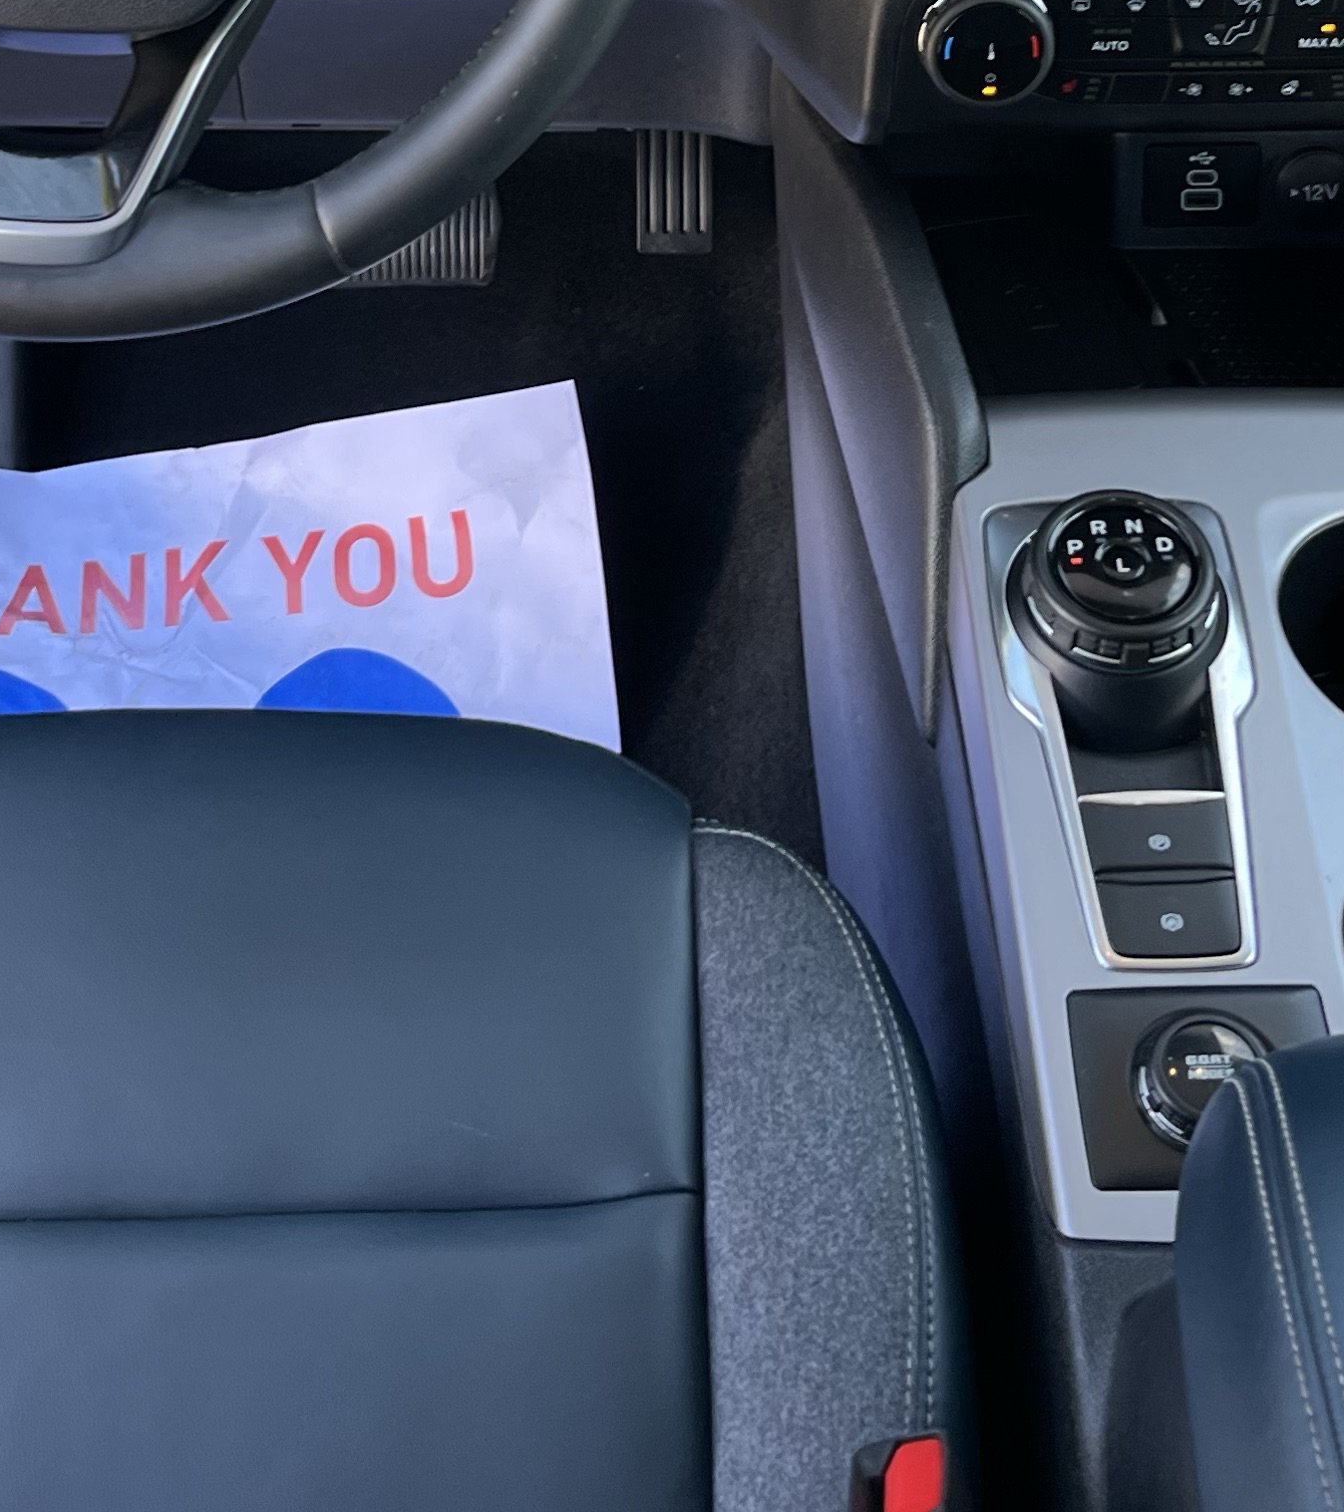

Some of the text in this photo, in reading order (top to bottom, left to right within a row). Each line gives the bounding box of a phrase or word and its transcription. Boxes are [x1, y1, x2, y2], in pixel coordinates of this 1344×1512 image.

[1091, 40, 1130, 51] AUTO
[1298, 37, 1329, 48] MAX
[1302, 183, 1340, 201] 12V
[1066, 518, 1174, 555] P R N D
[261, 509, 477, 616] YOU
[1116, 558, 1131, 573] L
